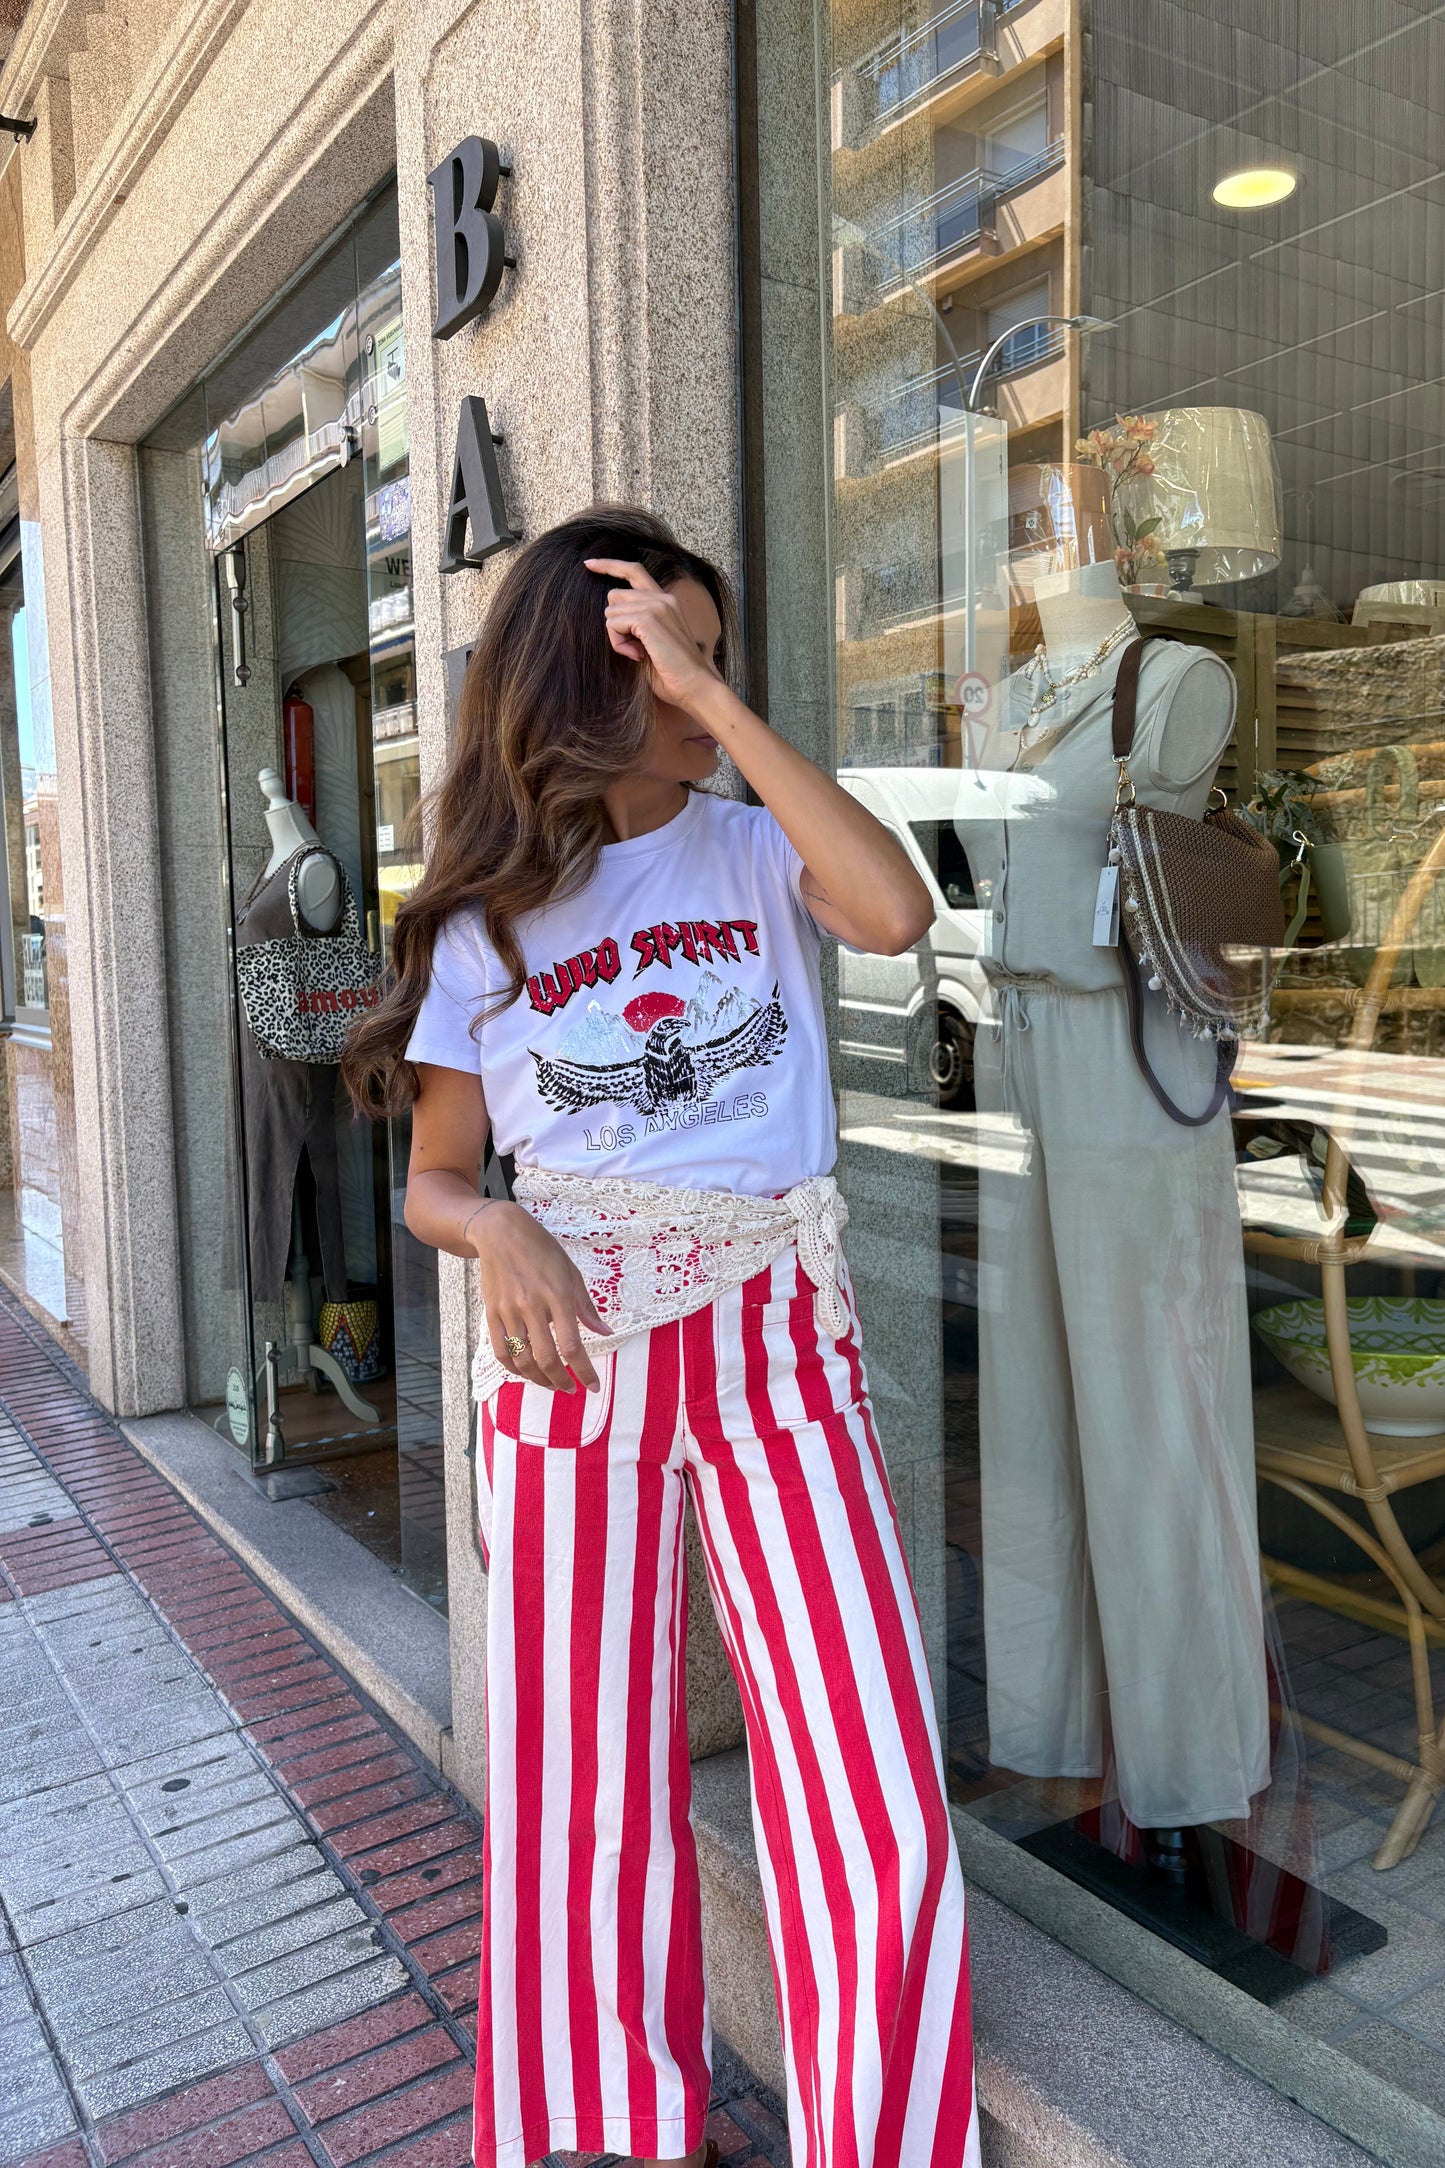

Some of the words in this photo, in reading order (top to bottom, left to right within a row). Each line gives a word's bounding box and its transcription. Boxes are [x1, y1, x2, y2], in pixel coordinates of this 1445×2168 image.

[527, 937, 622, 1017] WILD
[630, 919, 761, 981] SPIRIT
[296, 987, 383, 1014] amou
[584, 1124, 635, 1152] LOS
[643, 1092, 769, 1137] ANGELES
